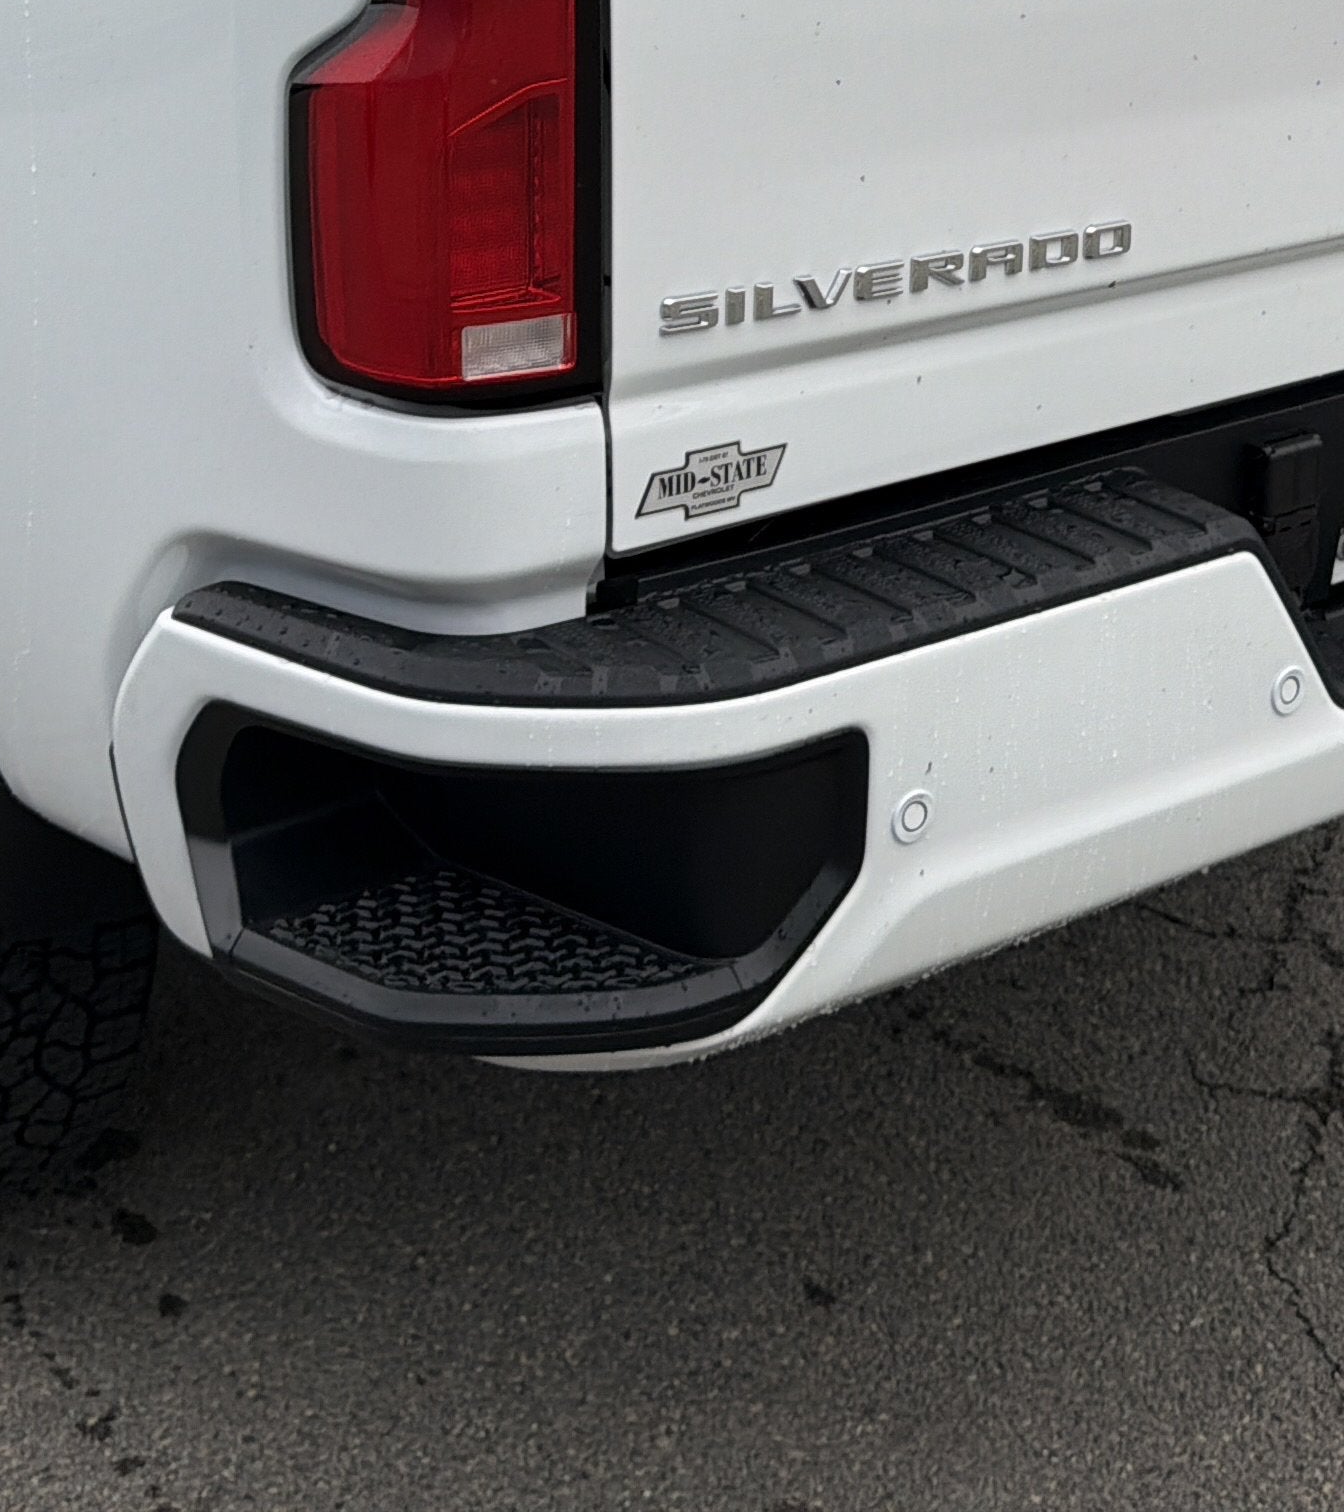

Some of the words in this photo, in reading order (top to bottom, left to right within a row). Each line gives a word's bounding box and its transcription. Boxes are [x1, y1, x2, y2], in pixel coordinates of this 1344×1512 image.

[658, 220, 1133, 337] SILVERADO
[658, 455, 767, 500] MID-STATE
[692, 485, 735, 499] CHEVROLET
